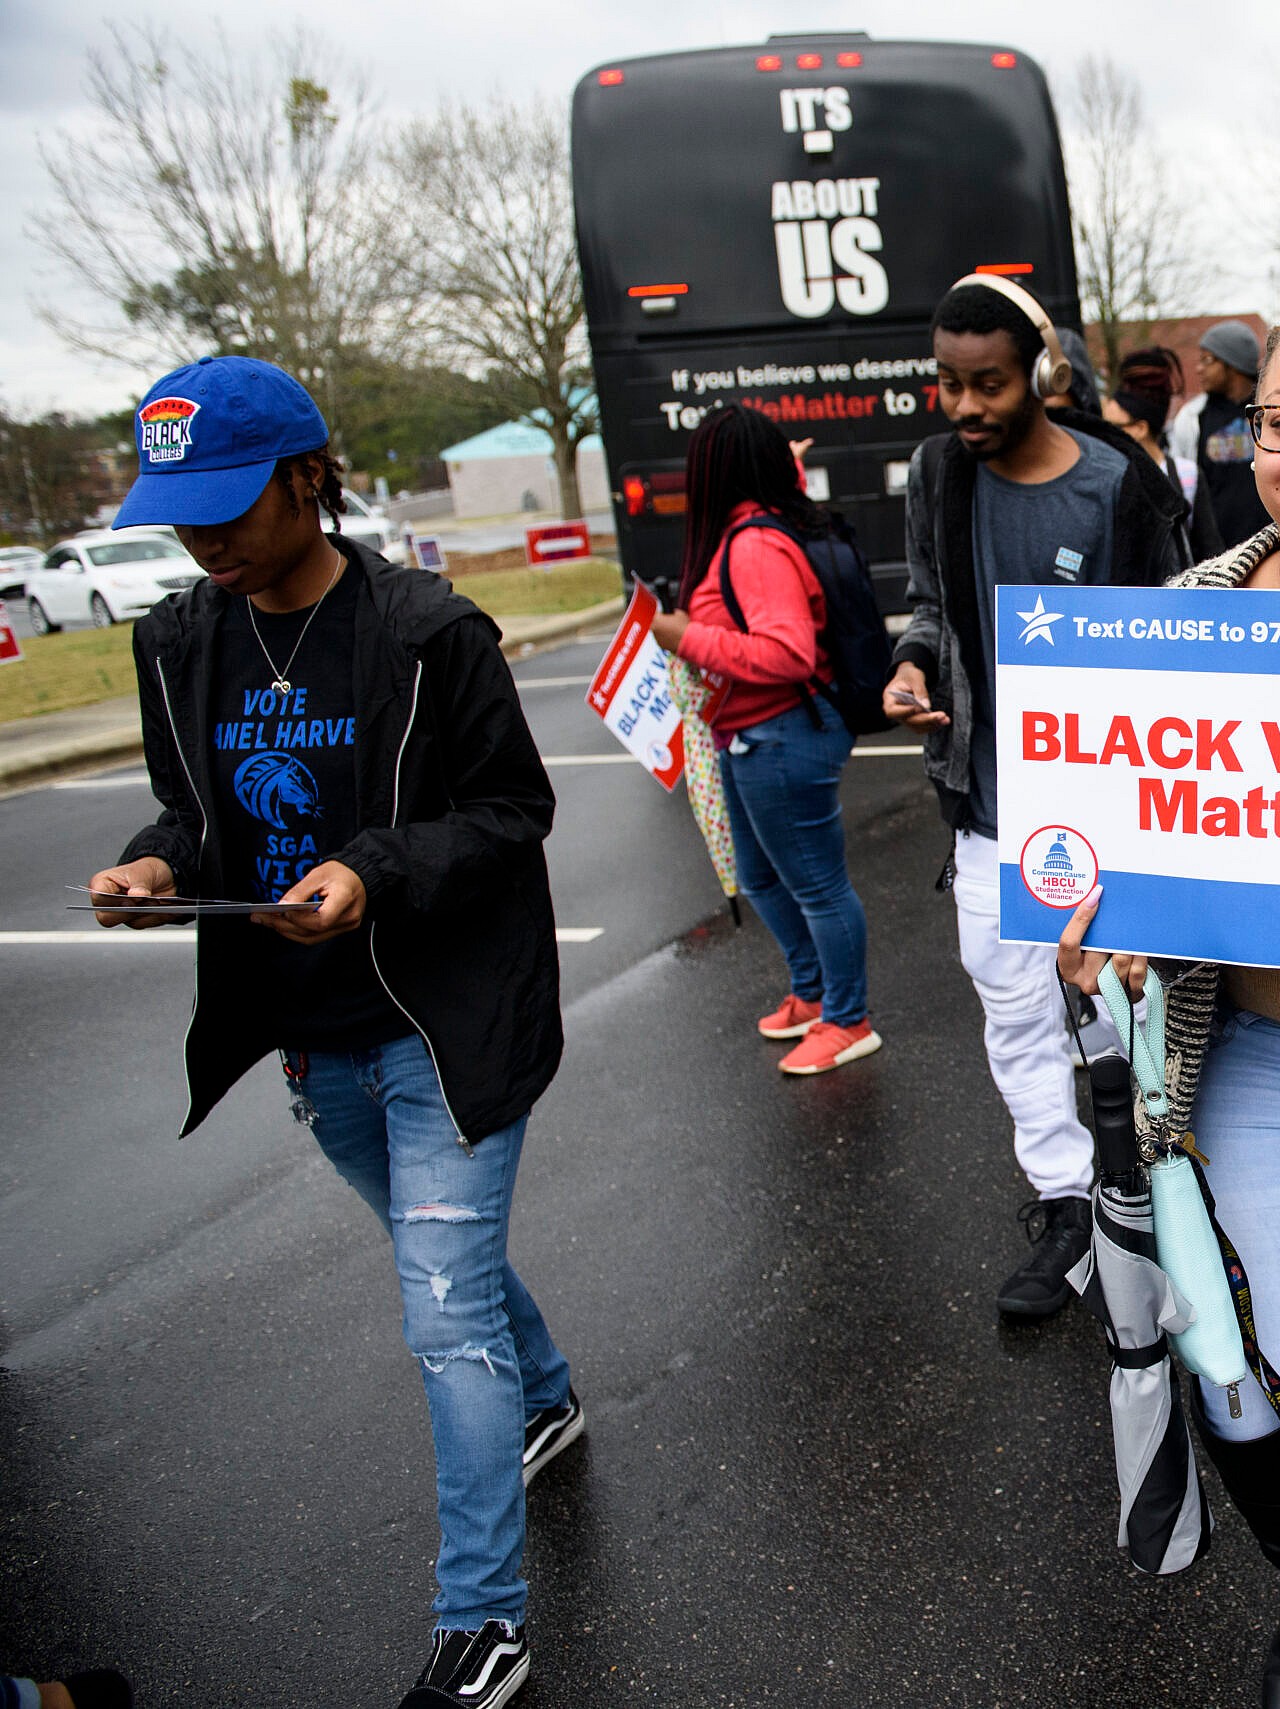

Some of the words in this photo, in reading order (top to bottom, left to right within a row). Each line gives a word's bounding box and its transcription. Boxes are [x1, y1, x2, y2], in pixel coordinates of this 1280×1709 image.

[780, 87, 853, 132] IT'S
[772, 177, 880, 220] ABOUT
[775, 216, 889, 318] US
[671, 368, 689, 392] If
[693, 370, 735, 395] you
[737, 363, 816, 387] believe
[817, 363, 851, 382] we
[853, 357, 938, 381] deserve
[883, 387, 916, 416] to
[145, 421, 189, 448] BLACK
[1073, 617, 1124, 639] Text
[1129, 618, 1214, 641] CAUSE
[1219, 621, 1245, 643] to
[243, 688, 307, 717] VOTE
[617, 668, 659, 737] BLACK
[1023, 711, 1244, 773] BLACK
[267, 834, 317, 857] SGA
[1032, 869, 1063, 878] Common
[1064, 871, 1087, 879] Cause
[1042, 876, 1076, 888] HBCU
[1046, 893, 1073, 901] Alliance
